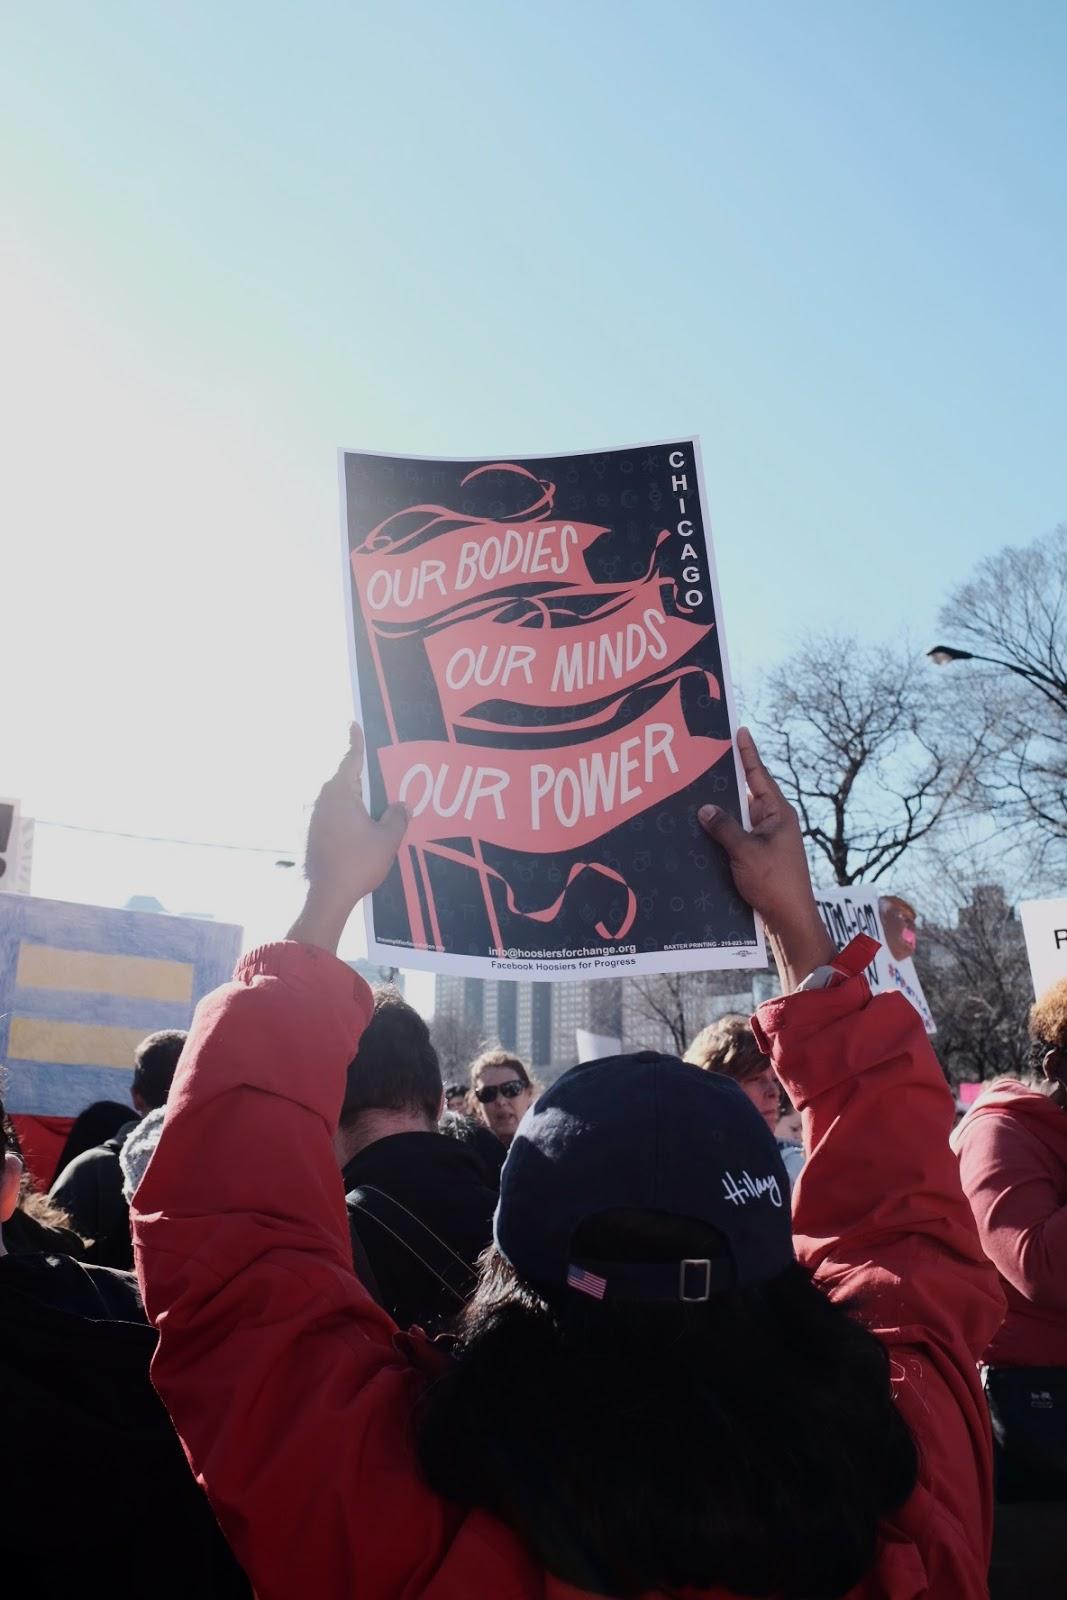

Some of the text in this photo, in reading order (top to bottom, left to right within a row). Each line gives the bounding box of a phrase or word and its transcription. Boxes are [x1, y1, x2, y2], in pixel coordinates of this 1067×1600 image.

[669, 451, 703, 607] CHICAGO
[367, 525, 578, 609] OUR BODIES
[446, 608, 667, 692] OUR MINDS
[399, 723, 679, 830] OUR POWER
[488, 945, 636, 960] info@hoosiersforchange.org
[491, 957, 637, 971] Facebook Hoosiers for Progress
[663, 943, 688, 951] BAXTER
[689, 941, 716, 949] PRINTING
[722, 1170, 783, 1208] Hillary
